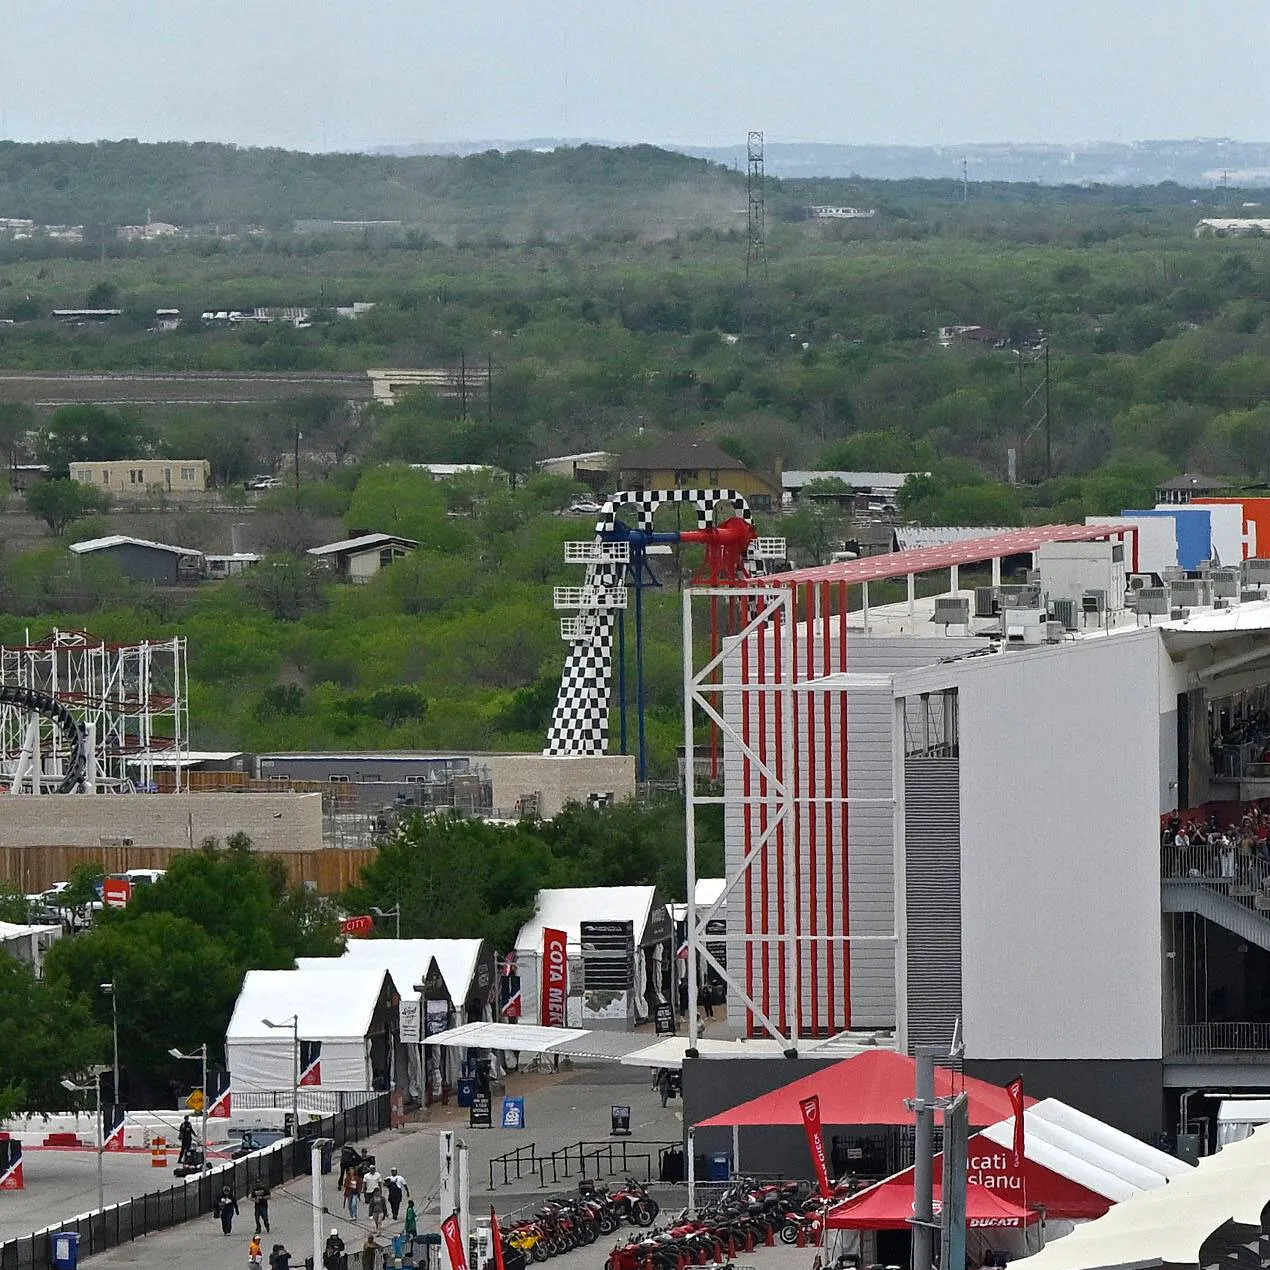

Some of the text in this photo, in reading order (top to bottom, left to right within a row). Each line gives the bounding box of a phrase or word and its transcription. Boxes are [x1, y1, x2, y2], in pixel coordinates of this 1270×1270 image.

[346, 918, 365, 931] CITY
[549, 940, 564, 1028] COTA MER
[969, 1217, 1019, 1227] DUCATI
